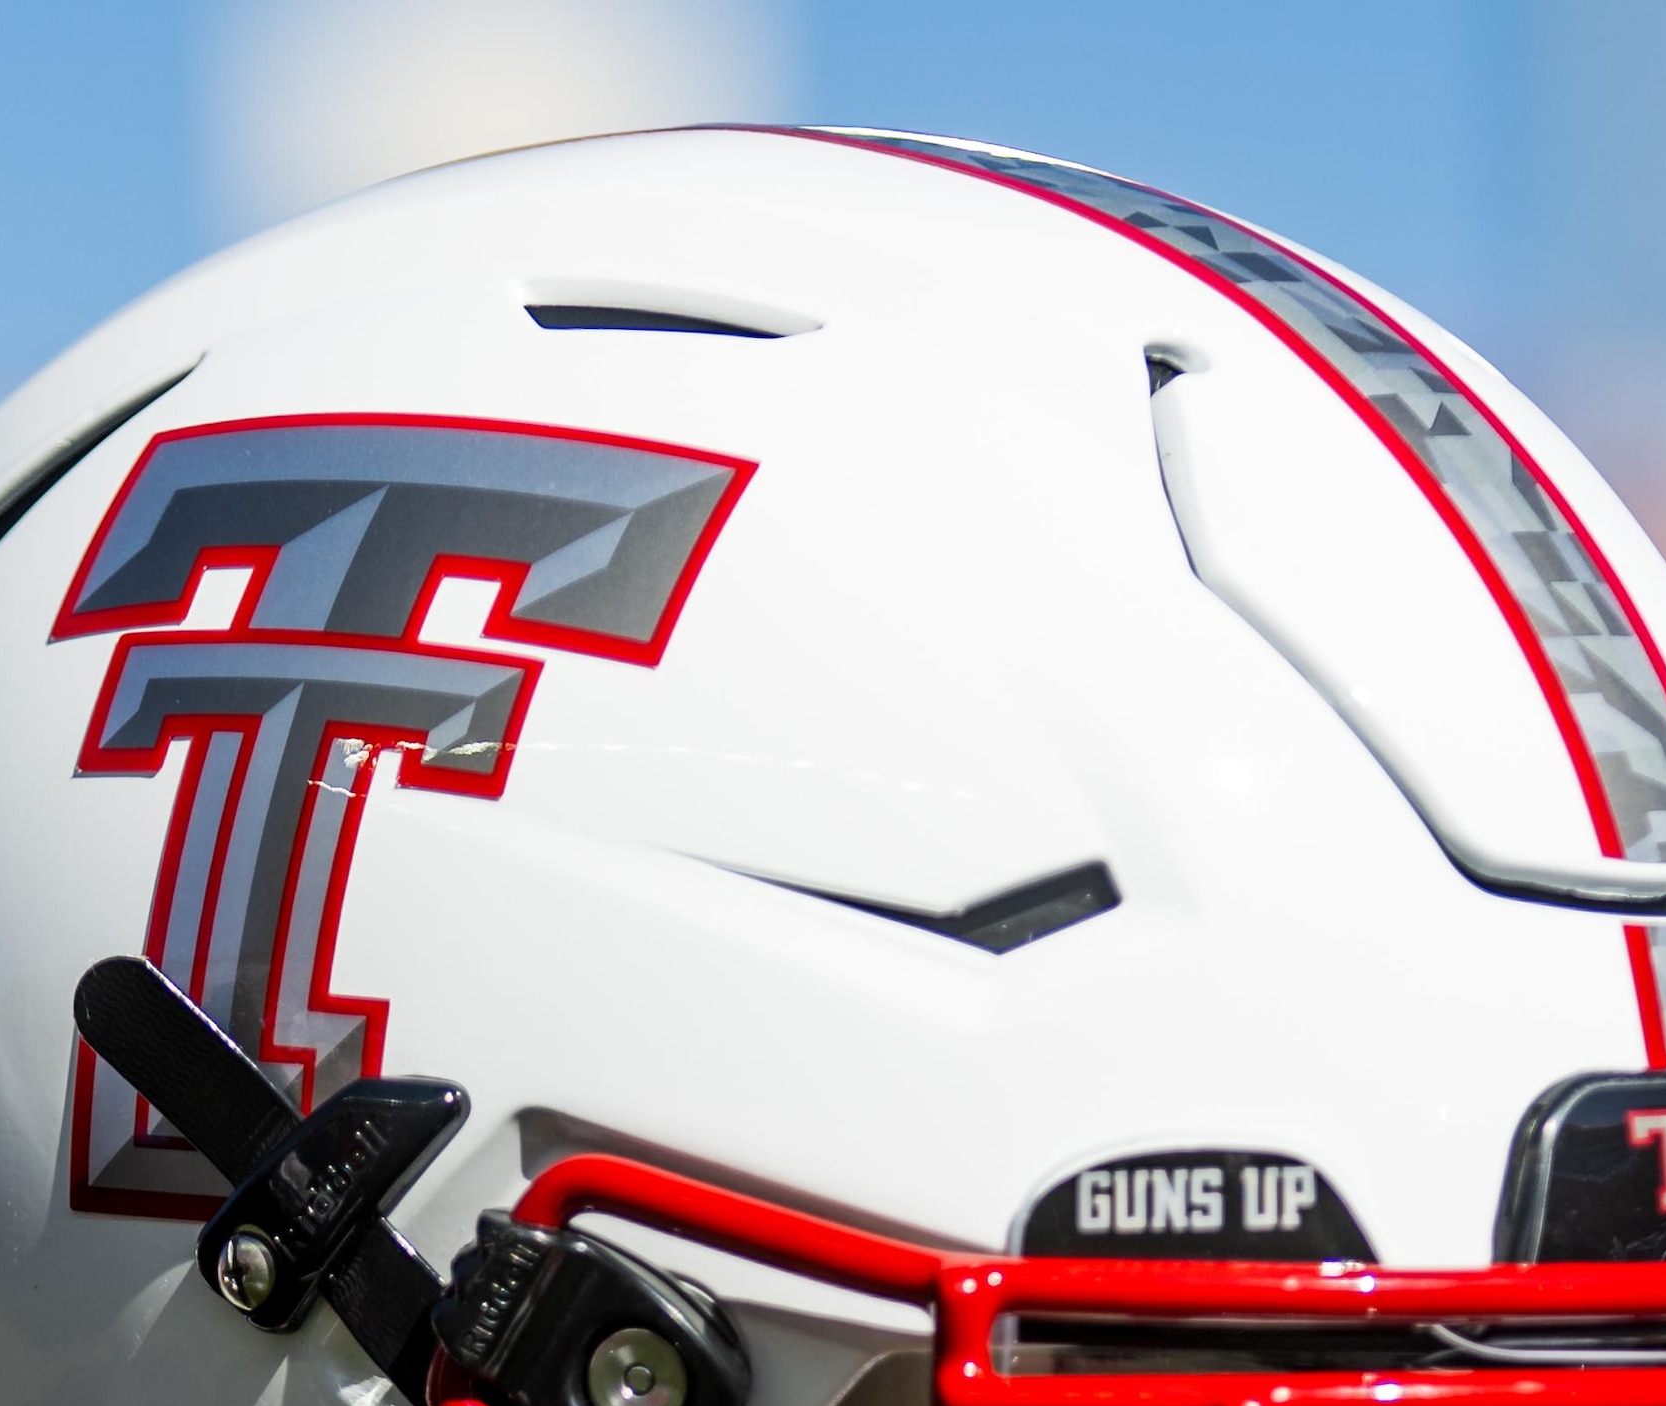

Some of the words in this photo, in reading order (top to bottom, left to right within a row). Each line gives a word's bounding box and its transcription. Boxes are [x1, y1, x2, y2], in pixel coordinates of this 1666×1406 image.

[1077, 1168, 1223, 1233] GUNS
[1242, 1166, 1316, 1231] UP
[460, 1243, 539, 1358] Riddell
